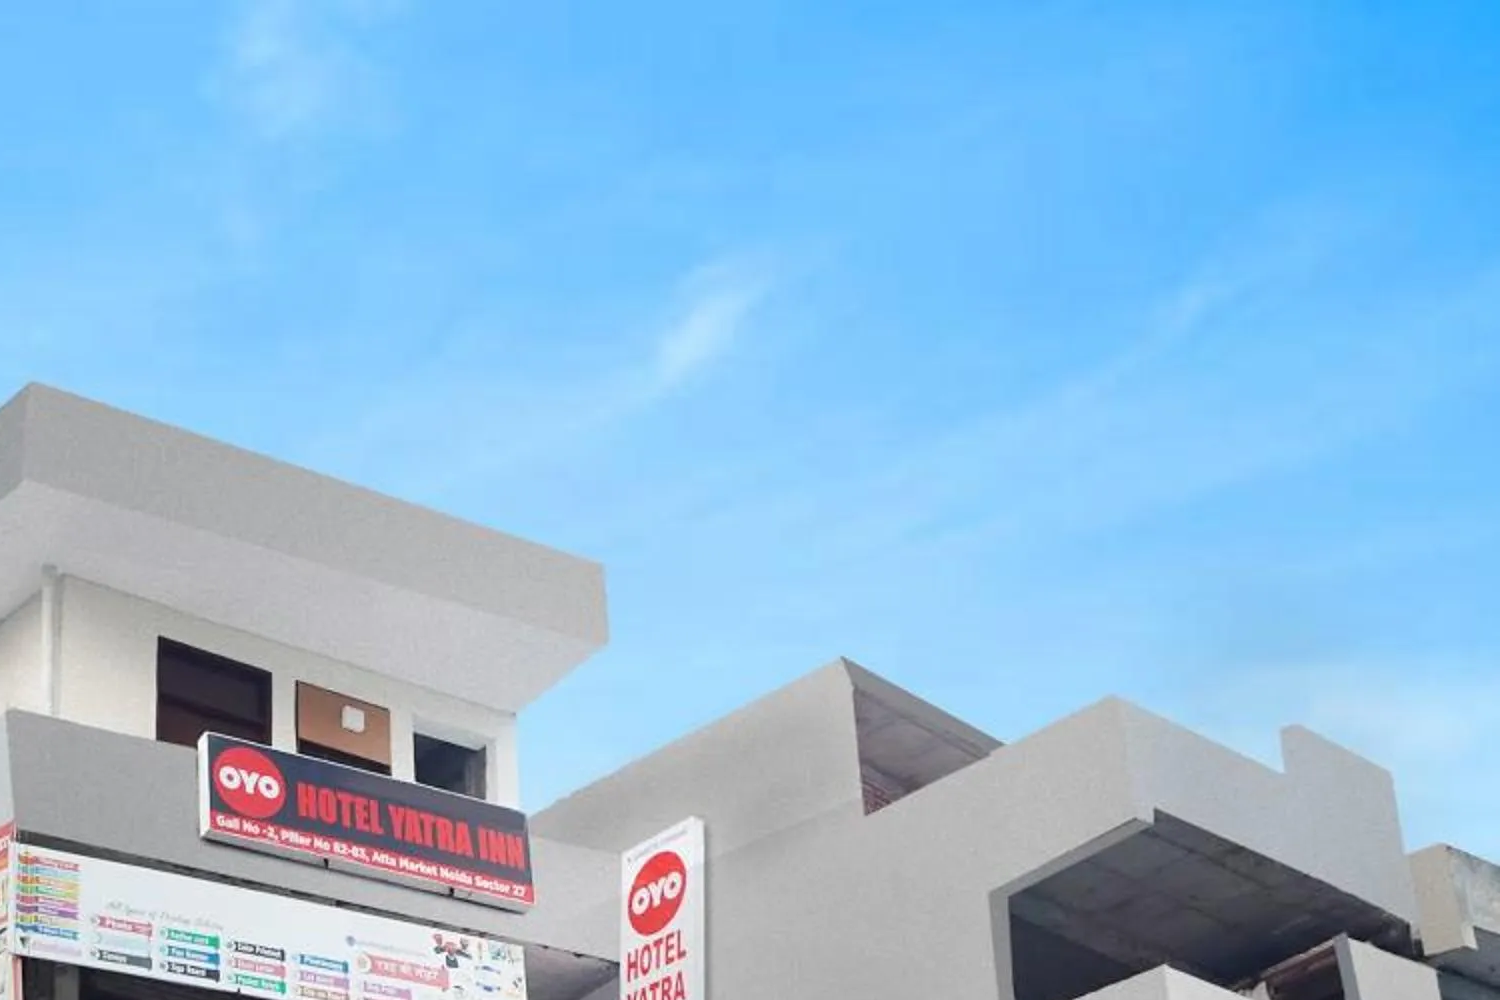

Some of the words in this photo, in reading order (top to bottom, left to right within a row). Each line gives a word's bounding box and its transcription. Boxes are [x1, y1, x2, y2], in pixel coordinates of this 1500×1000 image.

[219, 765, 280, 799] OYO
[297, 782, 384, 834] HOTEL
[388, 804, 474, 858] YATRA
[477, 824, 525, 871] INN
[632, 872, 682, 915] OYO
[627, 930, 687, 983] HOTEL
